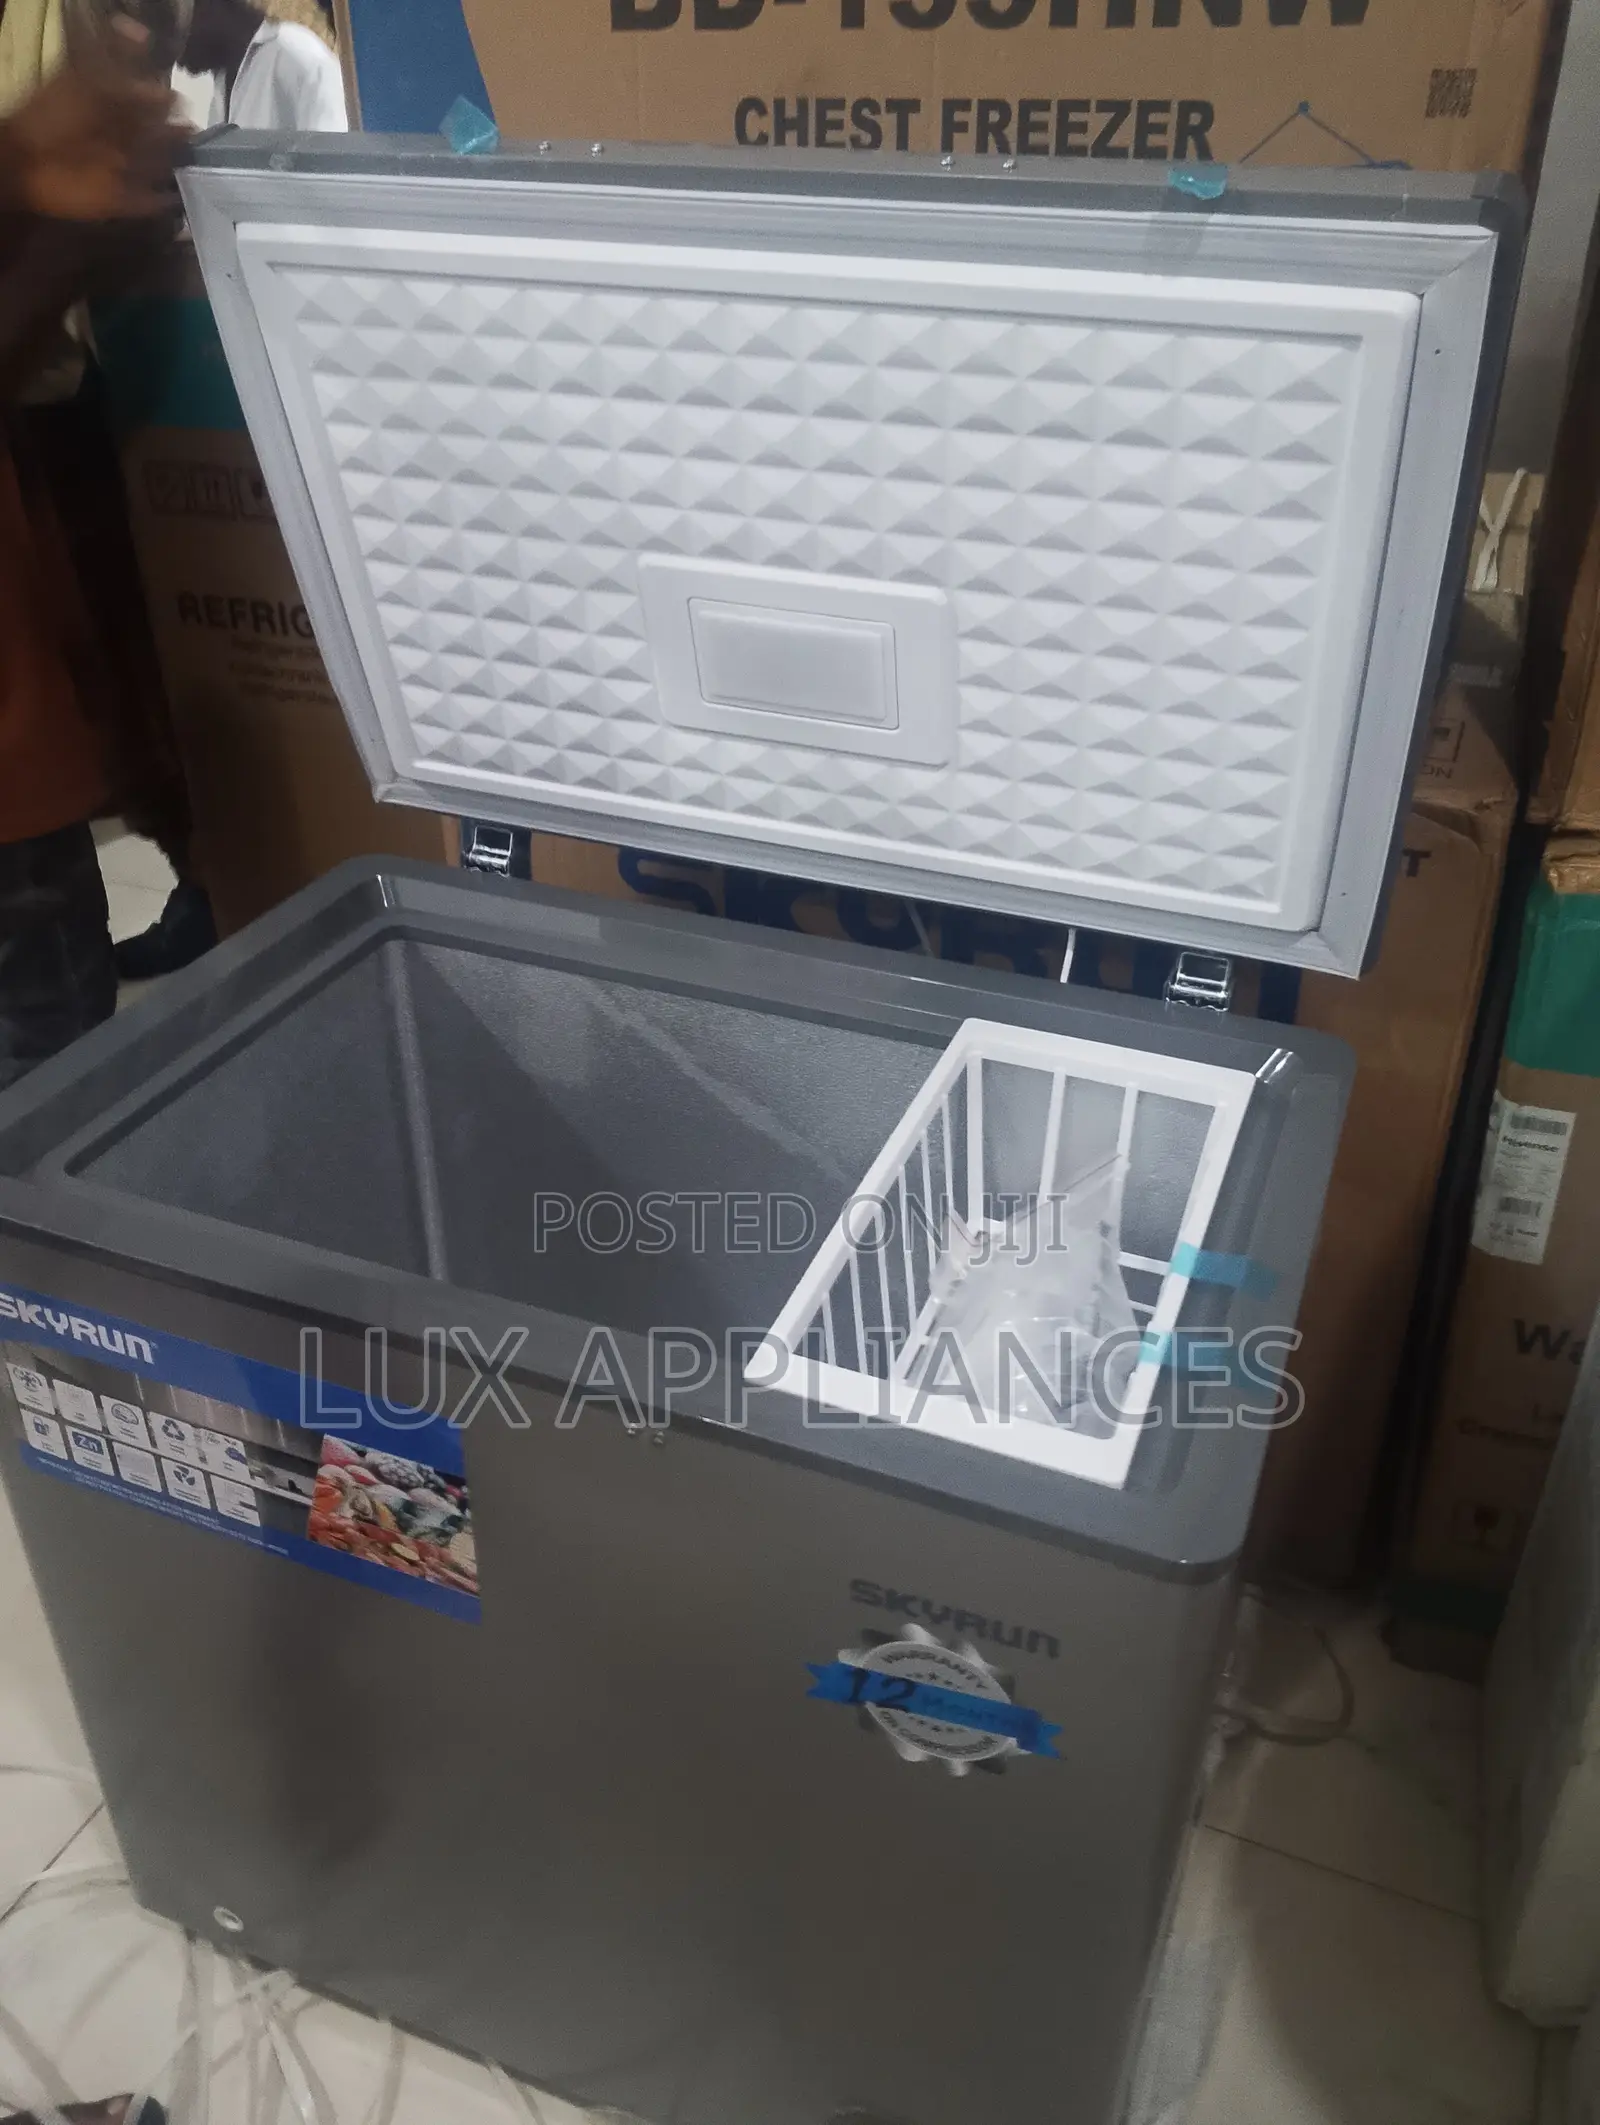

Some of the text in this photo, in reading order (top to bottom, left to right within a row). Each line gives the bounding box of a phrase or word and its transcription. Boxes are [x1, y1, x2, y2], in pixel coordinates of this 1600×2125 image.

[733, 96, 1214, 161] CHEST FREEZER
[846, 1667, 918, 1712] 12
